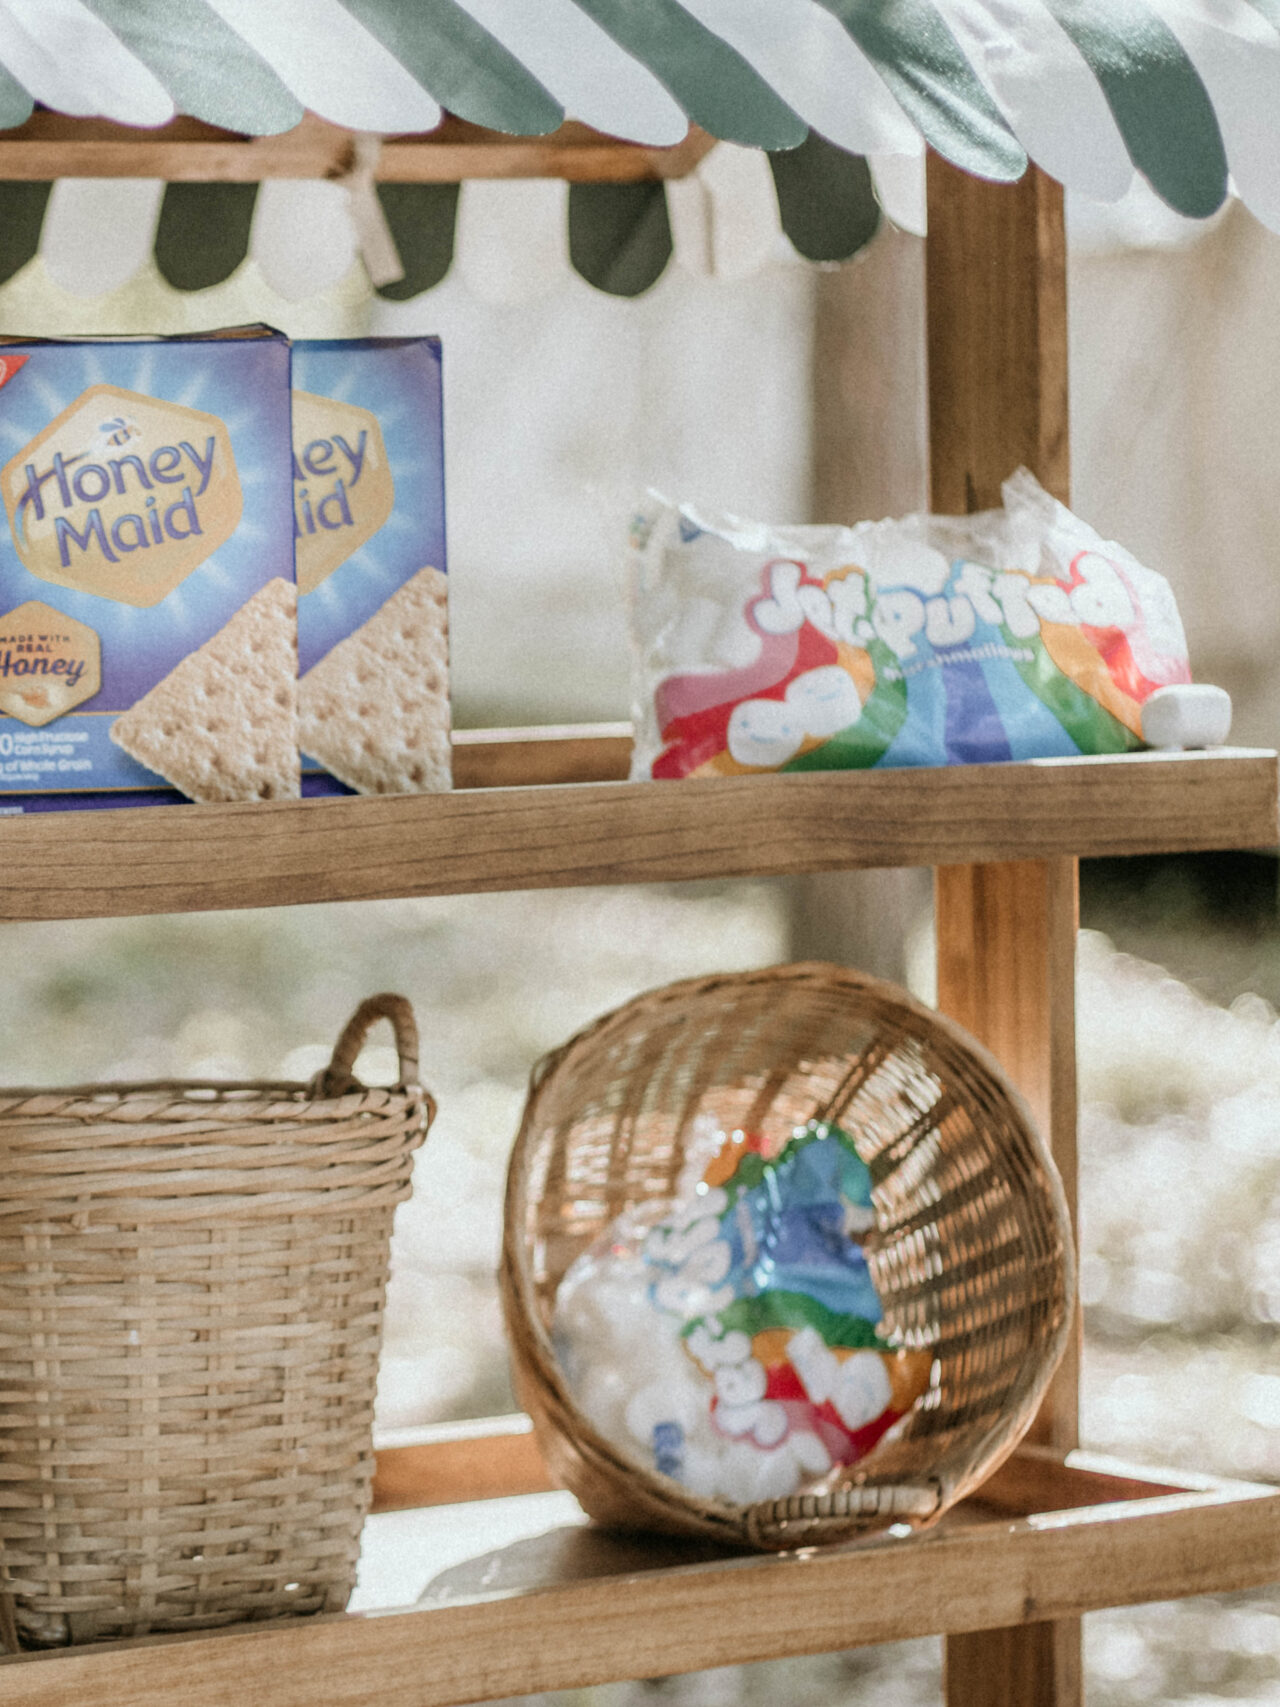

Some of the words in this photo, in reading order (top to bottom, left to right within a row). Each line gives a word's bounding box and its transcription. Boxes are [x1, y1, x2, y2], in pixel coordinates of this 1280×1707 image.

[18, 436, 216, 521] Honey
[54, 486, 204, 568] Maid
[16, 643, 53, 653] REAL
[38, 634, 71, 643] WITH
